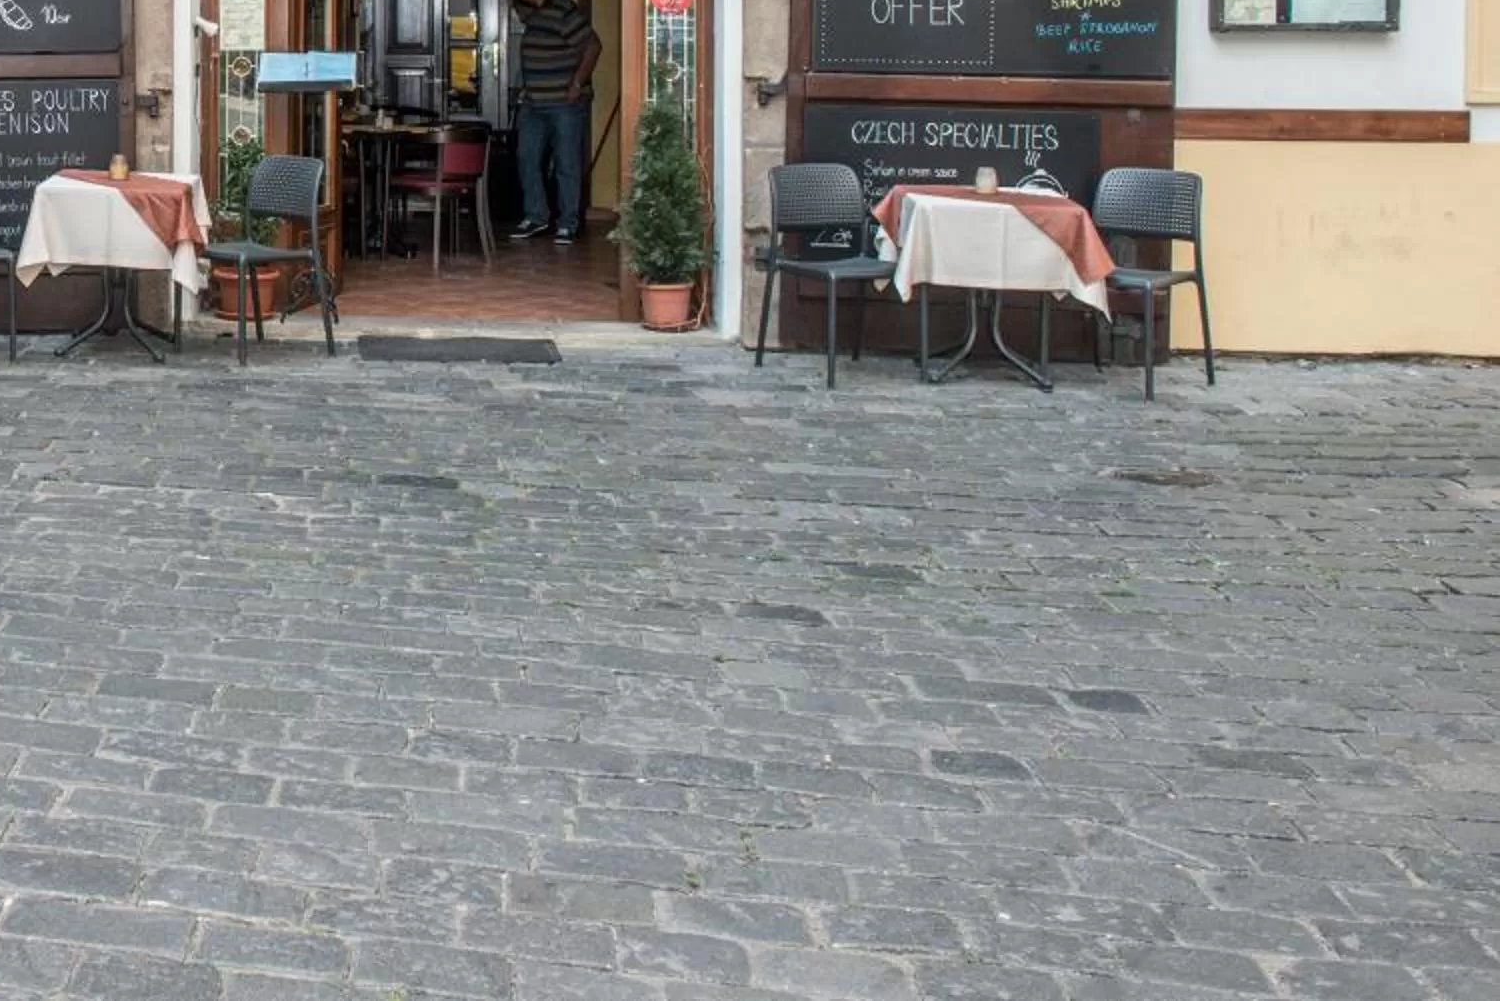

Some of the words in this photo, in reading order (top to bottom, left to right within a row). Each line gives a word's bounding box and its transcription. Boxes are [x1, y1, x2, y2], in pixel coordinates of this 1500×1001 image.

[31, 88, 110, 112] POULTRY
[851, 120, 915, 144] CZECH
[924, 121, 1060, 150] SPECIALTIES
